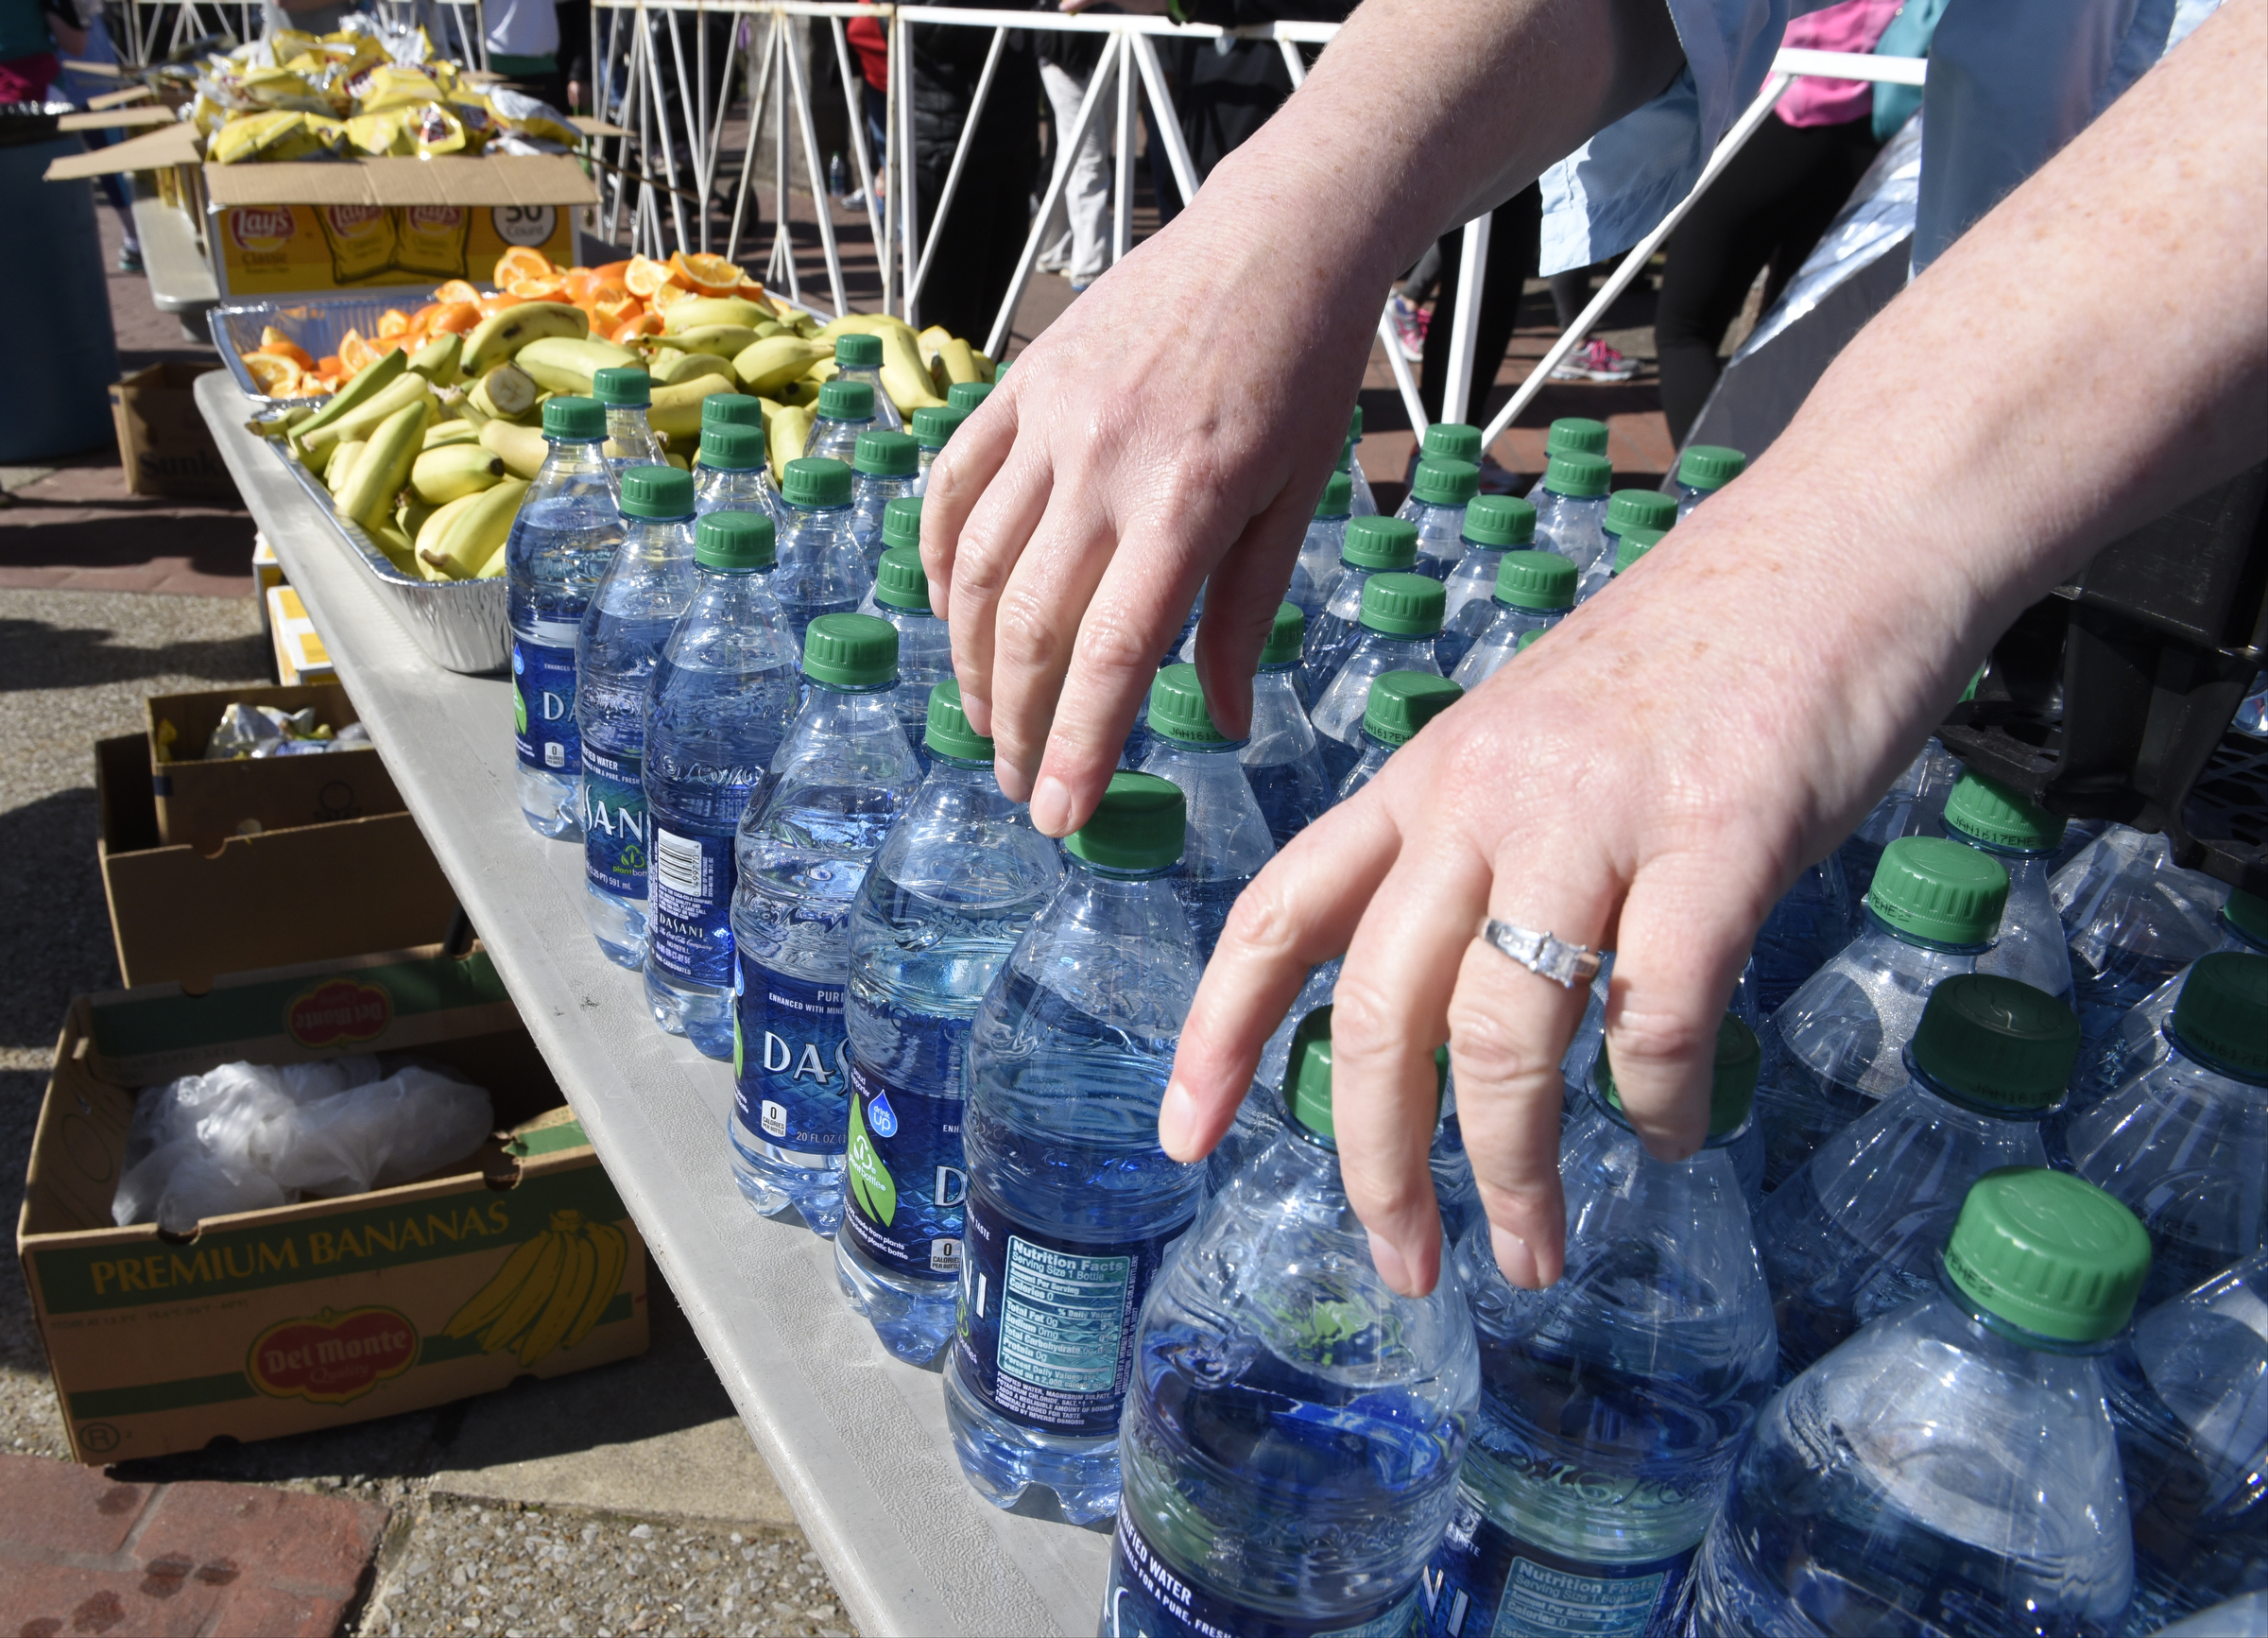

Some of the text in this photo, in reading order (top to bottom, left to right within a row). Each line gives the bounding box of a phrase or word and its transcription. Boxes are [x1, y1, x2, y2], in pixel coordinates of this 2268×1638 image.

[140, 448, 221, 479] Sunk
[552, 746, 558, 755] 0
[596, 755, 618, 771] WATER
[585, 784, 644, 844] SAN
[609, 876, 620, 888] 591
[612, 865, 648, 878] plantbott
[660, 913, 702, 939] DASANI
[769, 992, 845, 1015] ENHANCED WITH MINE
[817, 991, 844, 1003] PURI
[764, 1030, 849, 1096] DAS
[763, 1116, 785, 1129] CALORIES
[770, 1107, 777, 1120] 0
[873, 1105, 890, 1119] drink
[797, 1130, 808, 1142] 20
[810, 1133, 820, 1144] FL
[822, 1134, 835, 1144] OZ
[91, 1200, 510, 1296] PREMIUM BANANAS
[868, 1227, 883, 1241] from
[883, 1237, 905, 1250] plants
[944, 1243, 953, 1256] 0
[887, 1247, 908, 1260] bottle
[1012, 1240, 1124, 1271] Nutrition Facts
[1012, 1252, 1105, 1281] Serving Size 1 Bottle
[1008, 1278, 1054, 1302] Calories 0
[1009, 1267, 1080, 1296] Amount Per Serving
[1125, 1285, 1134, 1314] COCA-COLA
[1005, 1314, 1037, 1333] Sodium
[1038, 1325, 1058, 1340] 0mg
[1006, 1300, 1058, 1328] Total Fat 0g
[265, 1330, 407, 1374] Del Monte
[1003, 1337, 1048, 1363] Protein 0g
[1005, 1325, 1023, 1340] Total
[1024, 1333, 1081, 1354] Carbohydrate
[996, 1378, 1059, 1405] POTASSIUM CHLORIDE,
[997, 1371, 1022, 1388] PURIFIED
[1022, 1383, 1044, 1395] WATER,
[1046, 1390, 1084, 1400] MAGNESIUM
[995, 1396, 1085, 1426] PURIFIED BY REVERSE OSMOSIS
[1019, 1393, 1054, 1410] NEGLIGIBLE
[1054, 1403, 1081, 1413] AMOUNT
[1091, 1404, 1115, 1413] SODIUM
[1026, 1405, 1047, 1416] ADDED
[1048, 1409, 1061, 1418] FOR
[1149, 1556, 1193, 1607] WATER
[1515, 1575, 1559, 1597] Serving
[1564, 1589, 1588, 1603] Size
[1519, 1562, 1655, 1594] Nutrition Facts
[1139, 1568, 1154, 1594] FOR
[1155, 1588, 1160, 1601] A
[1162, 1595, 1192, 1626] PURE,
[1559, 1617, 1569, 1628] 0
